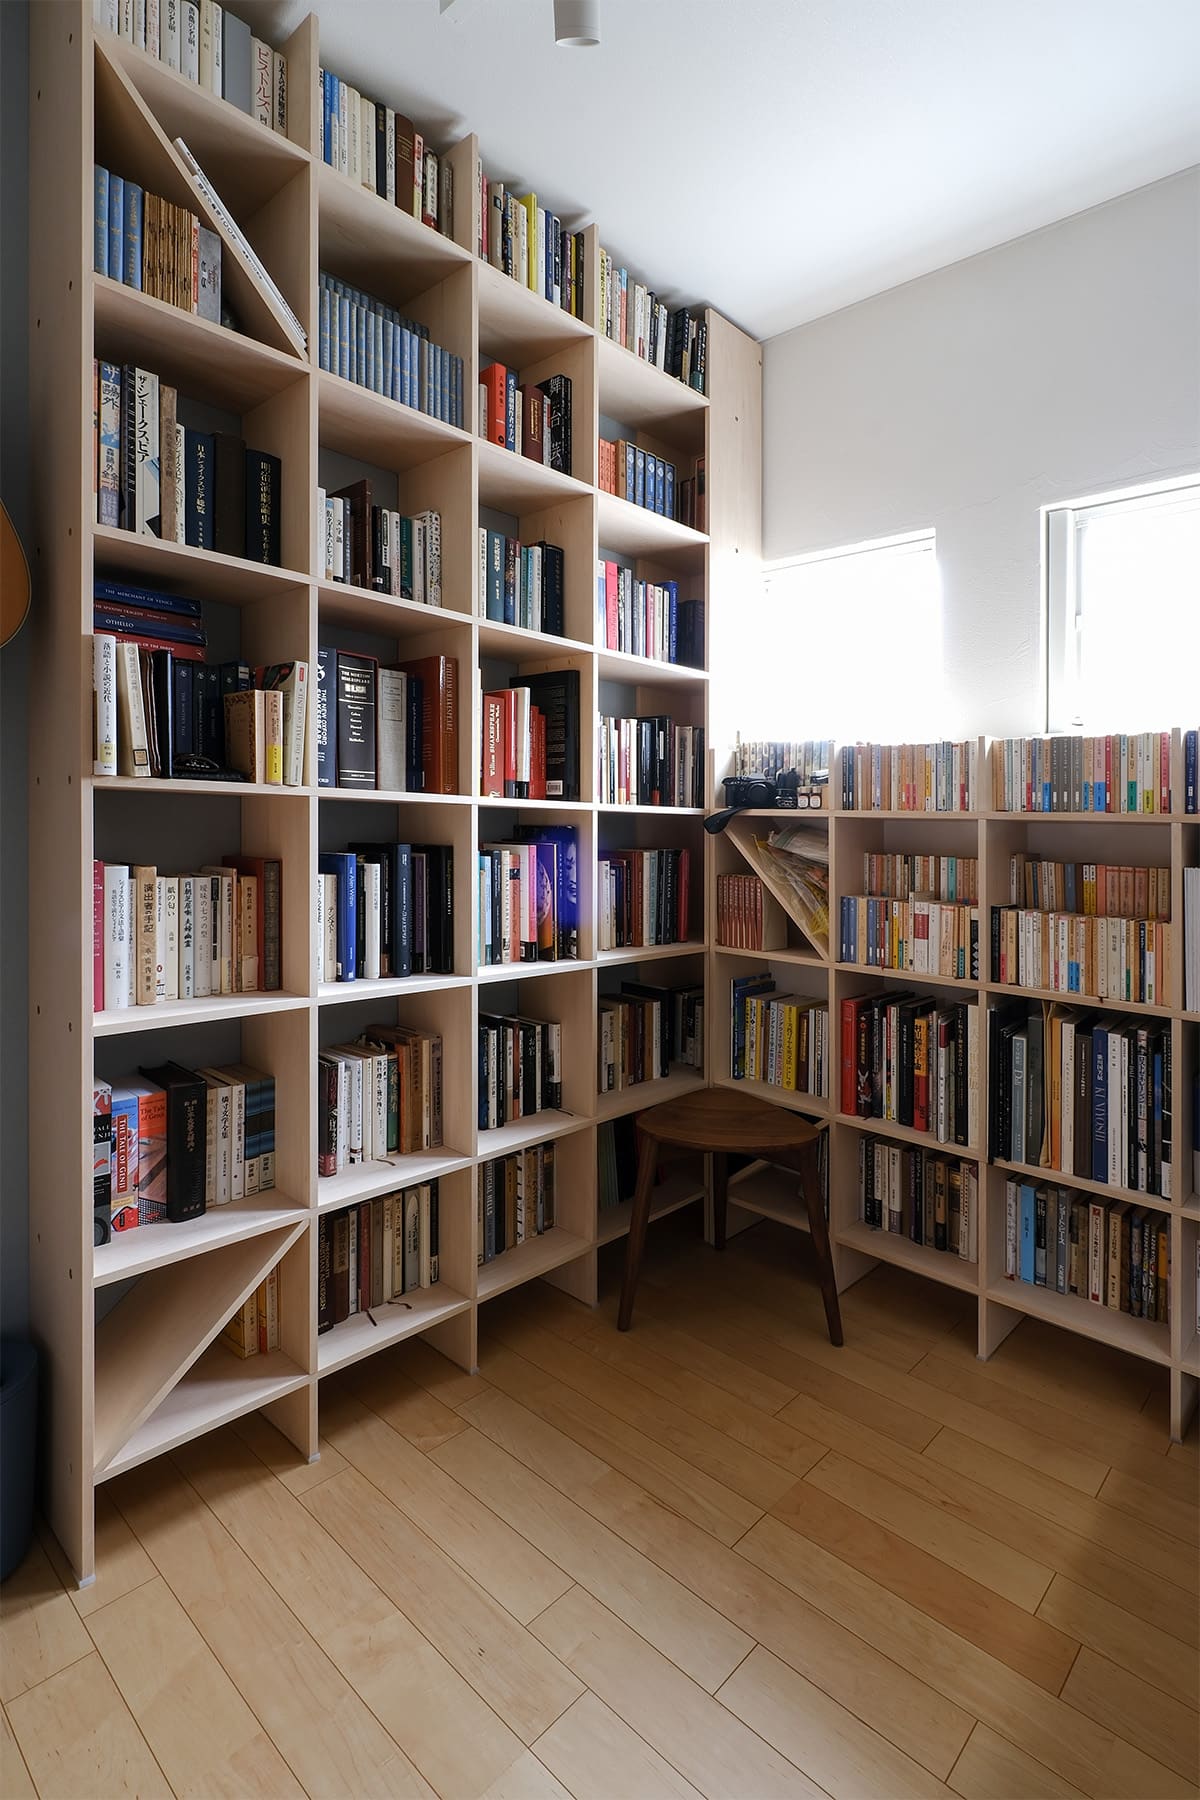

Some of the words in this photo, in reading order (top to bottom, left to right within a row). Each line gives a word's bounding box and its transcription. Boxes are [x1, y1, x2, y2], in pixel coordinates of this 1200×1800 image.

[105, 618, 135, 629] OTHELLO
[119, 1119, 127, 1134] THE
[119, 1136, 127, 1153] TALE
[119, 1166, 127, 1189] GENJI
